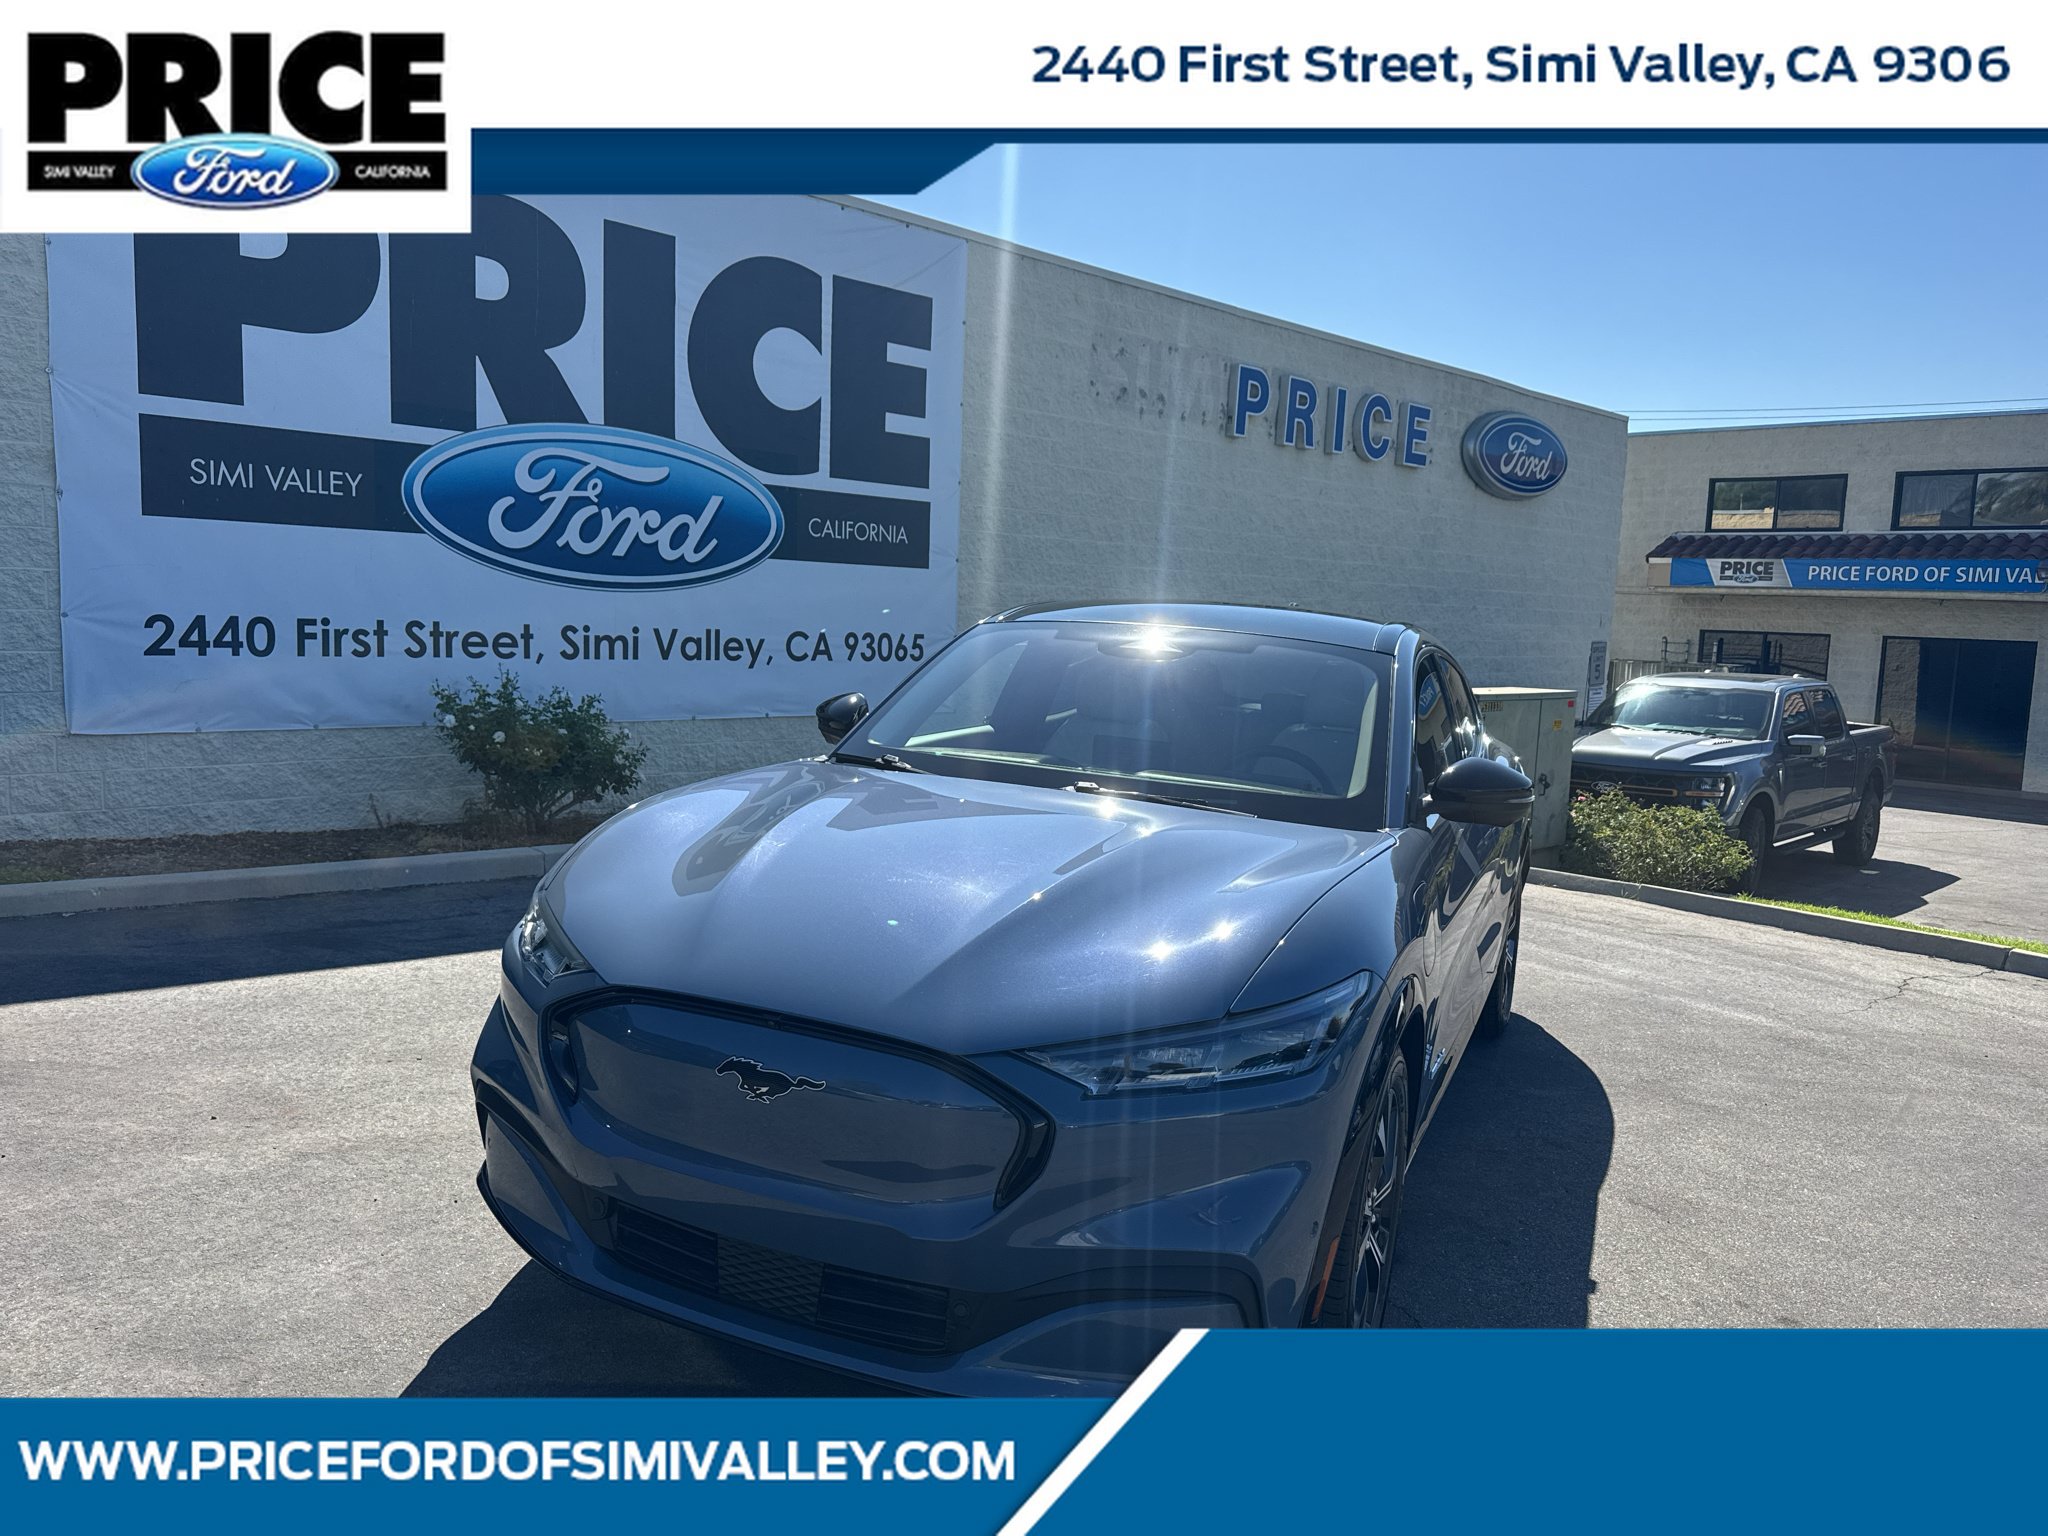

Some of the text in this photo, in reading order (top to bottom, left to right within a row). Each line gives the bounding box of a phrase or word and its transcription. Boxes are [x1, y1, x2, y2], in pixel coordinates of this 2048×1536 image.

[134, 195, 934, 490] PRICE
[1231, 363, 1432, 468] PRICE
[190, 457, 362, 498] SIMI VALLEY
[1500, 432, 1553, 480] Ford
[488, 448, 723, 563] Ford
[808, 517, 908, 545] CALIFORNIA
[1720, 561, 1774, 576] PRICE
[1808, 565, 1861, 582] PRICE
[1866, 566, 1919, 583] FORD
[1924, 567, 1950, 583] OF
[1956, 567, 2000, 583] SIMI
[144, 614, 926, 669] 2440 First Street, Simi Valley, CA 93065
